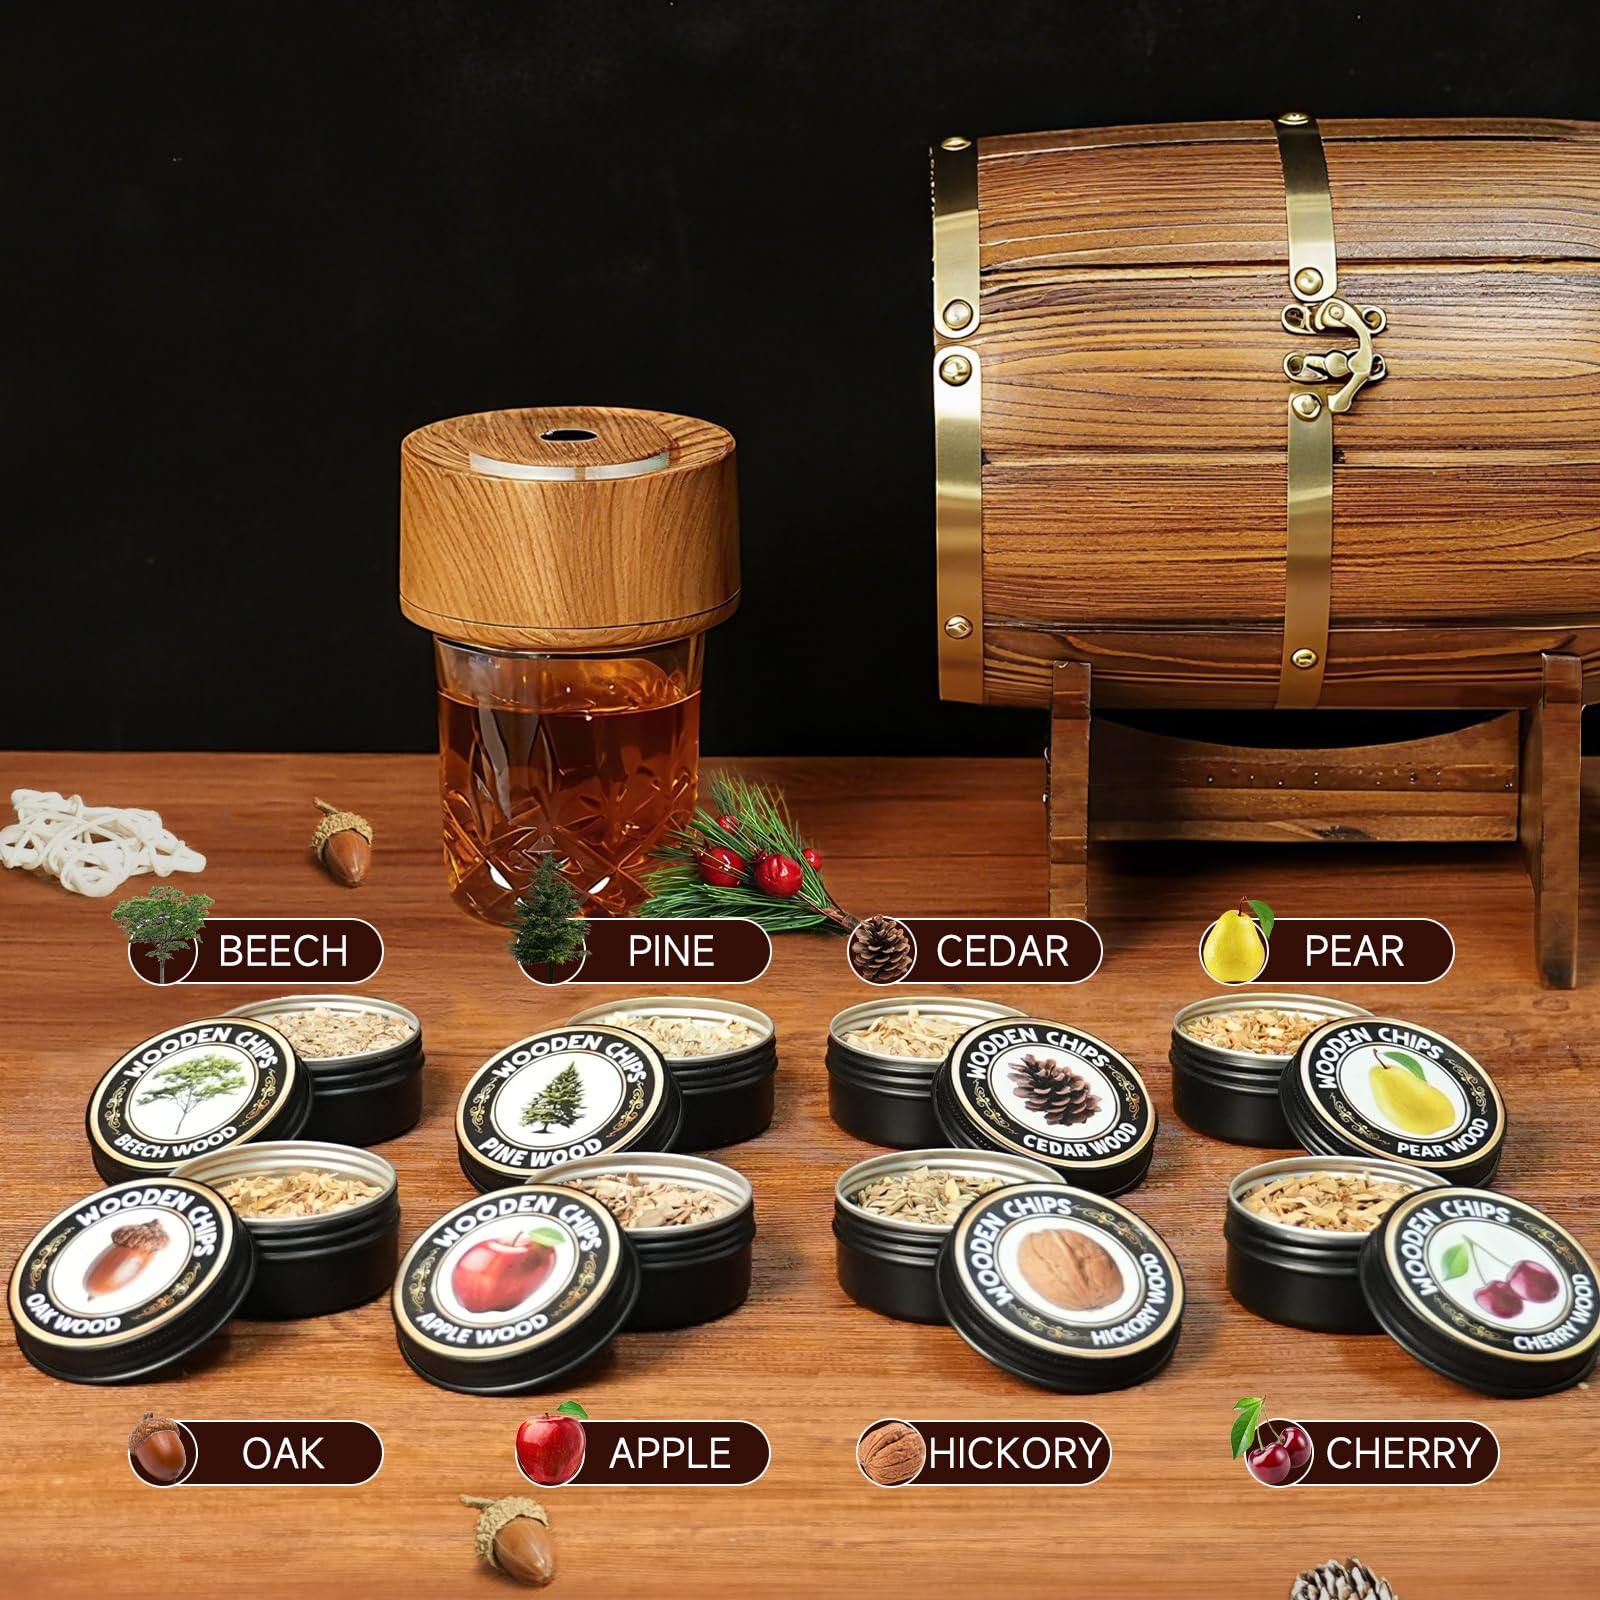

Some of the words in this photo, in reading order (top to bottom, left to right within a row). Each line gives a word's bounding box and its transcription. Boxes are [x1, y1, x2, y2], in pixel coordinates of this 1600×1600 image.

[124, 1027, 232, 1079] WOODEN
[234, 1031, 278, 1069] CHIPS
[494, 1035, 602, 1080] WOODEN
[605, 1042, 646, 1084] CHIPS
[966, 1027, 1038, 1080] WOODEN
[1046, 1030, 1109, 1068] CHIPS
[1315, 1027, 1372, 1089] WOODEN
[1378, 1027, 1444, 1059] CHIPS
[114, 1133, 169, 1158] BEECH
[171, 1125, 238, 1157] WOOD
[478, 1137, 527, 1166] PINE
[529, 1138, 602, 1168] WOOD
[1022, 1133, 1091, 1157] CEDAR
[1091, 1122, 1138, 1157] WOOD
[1397, 1142, 1448, 1157] PEAR
[1446, 1118, 1489, 1155] WOOD
[75, 1188, 195, 1227] WOODEN
[188, 1205, 217, 1258] CHIPS
[433, 1195, 557, 1249] WOODEN
[558, 1204, 602, 1252] CHIPS
[1400, 1207, 1440, 1297] WOODEN
[1440, 1199, 1511, 1224] CHIPS
[970, 1212, 1014, 1307] WOODEN
[1003, 1196, 1072, 1219] CHIPS
[26, 1293, 58, 1325] OAK
[54, 1315, 121, 1334] WOOD
[1090, 1304, 1160, 1347] HICKORY
[1139, 1252, 1166, 1307] WOOD
[1513, 1320, 1580, 1352] CHERRY
[1569, 1273, 1593, 1325] WOOD
[416, 1312, 474, 1343] APPLE
[475, 1313, 548, 1344] WOOD
